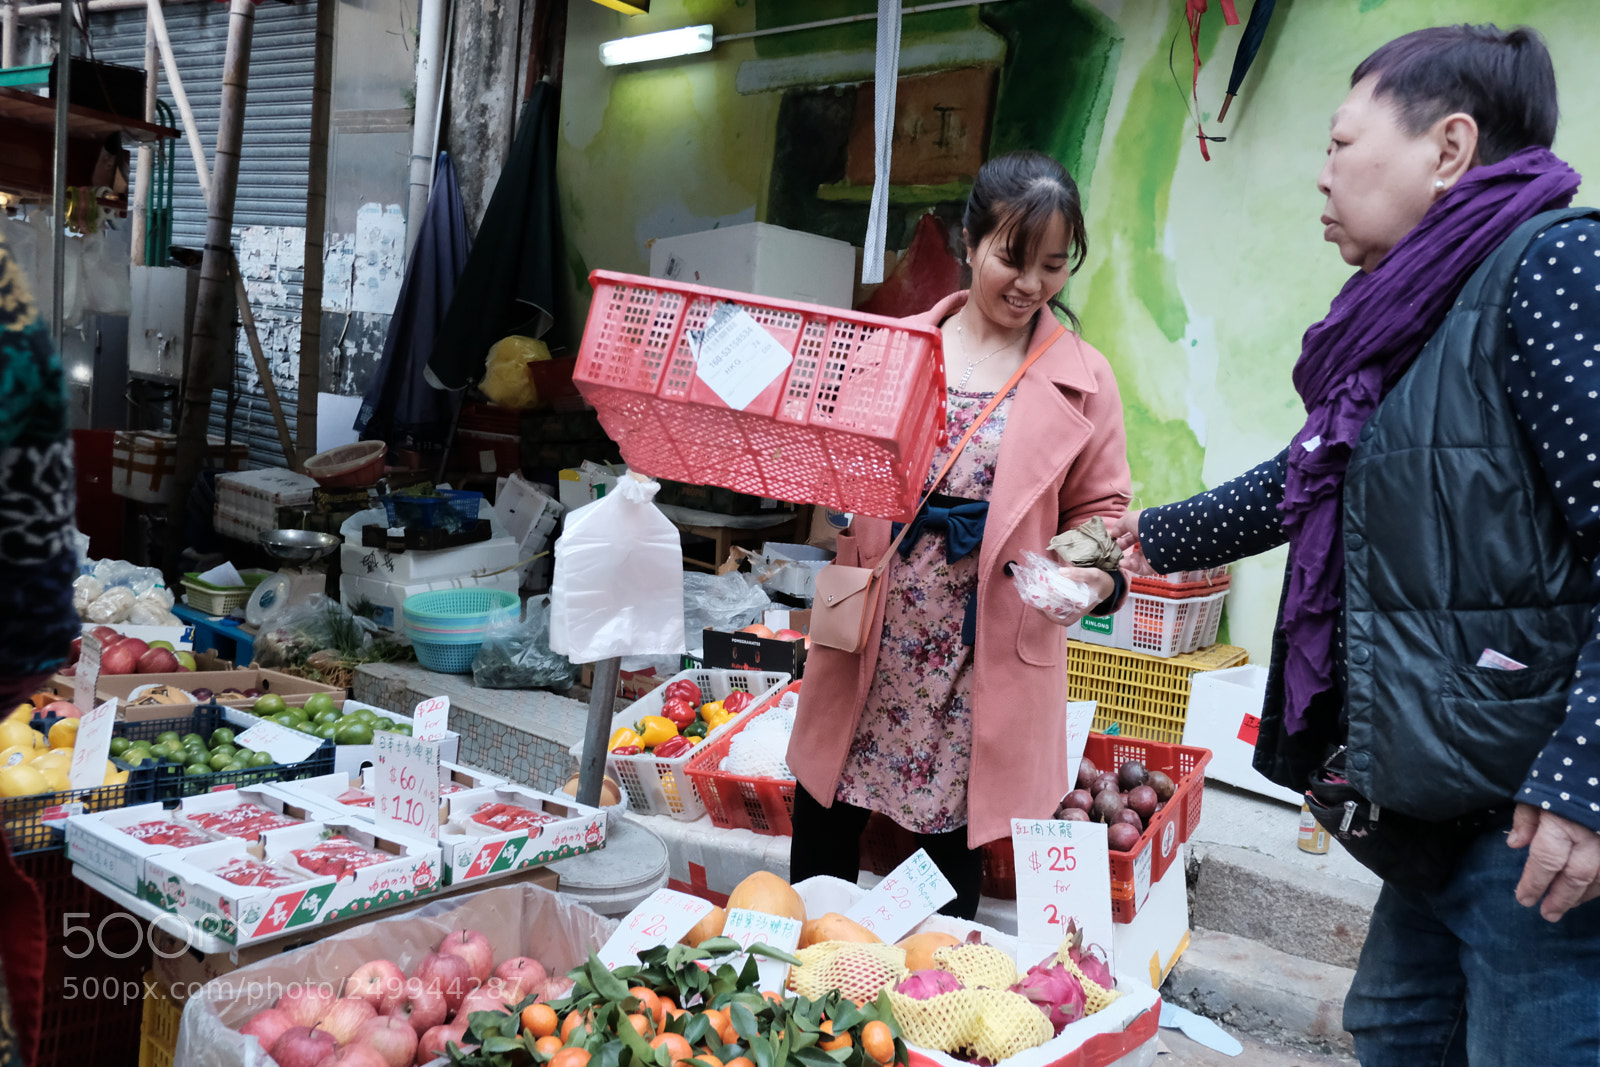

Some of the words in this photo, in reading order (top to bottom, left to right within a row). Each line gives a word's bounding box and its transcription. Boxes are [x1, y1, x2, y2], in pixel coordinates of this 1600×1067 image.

[417, 699, 445, 718] $20
[424, 719, 440, 729] for
[369, 875, 411, 894] ゆめのか
[883, 879, 912, 909] $20
[1053, 880, 1071, 893] for
[267, 892, 322, 926] 長崎
[629, 913, 668, 937] $20
